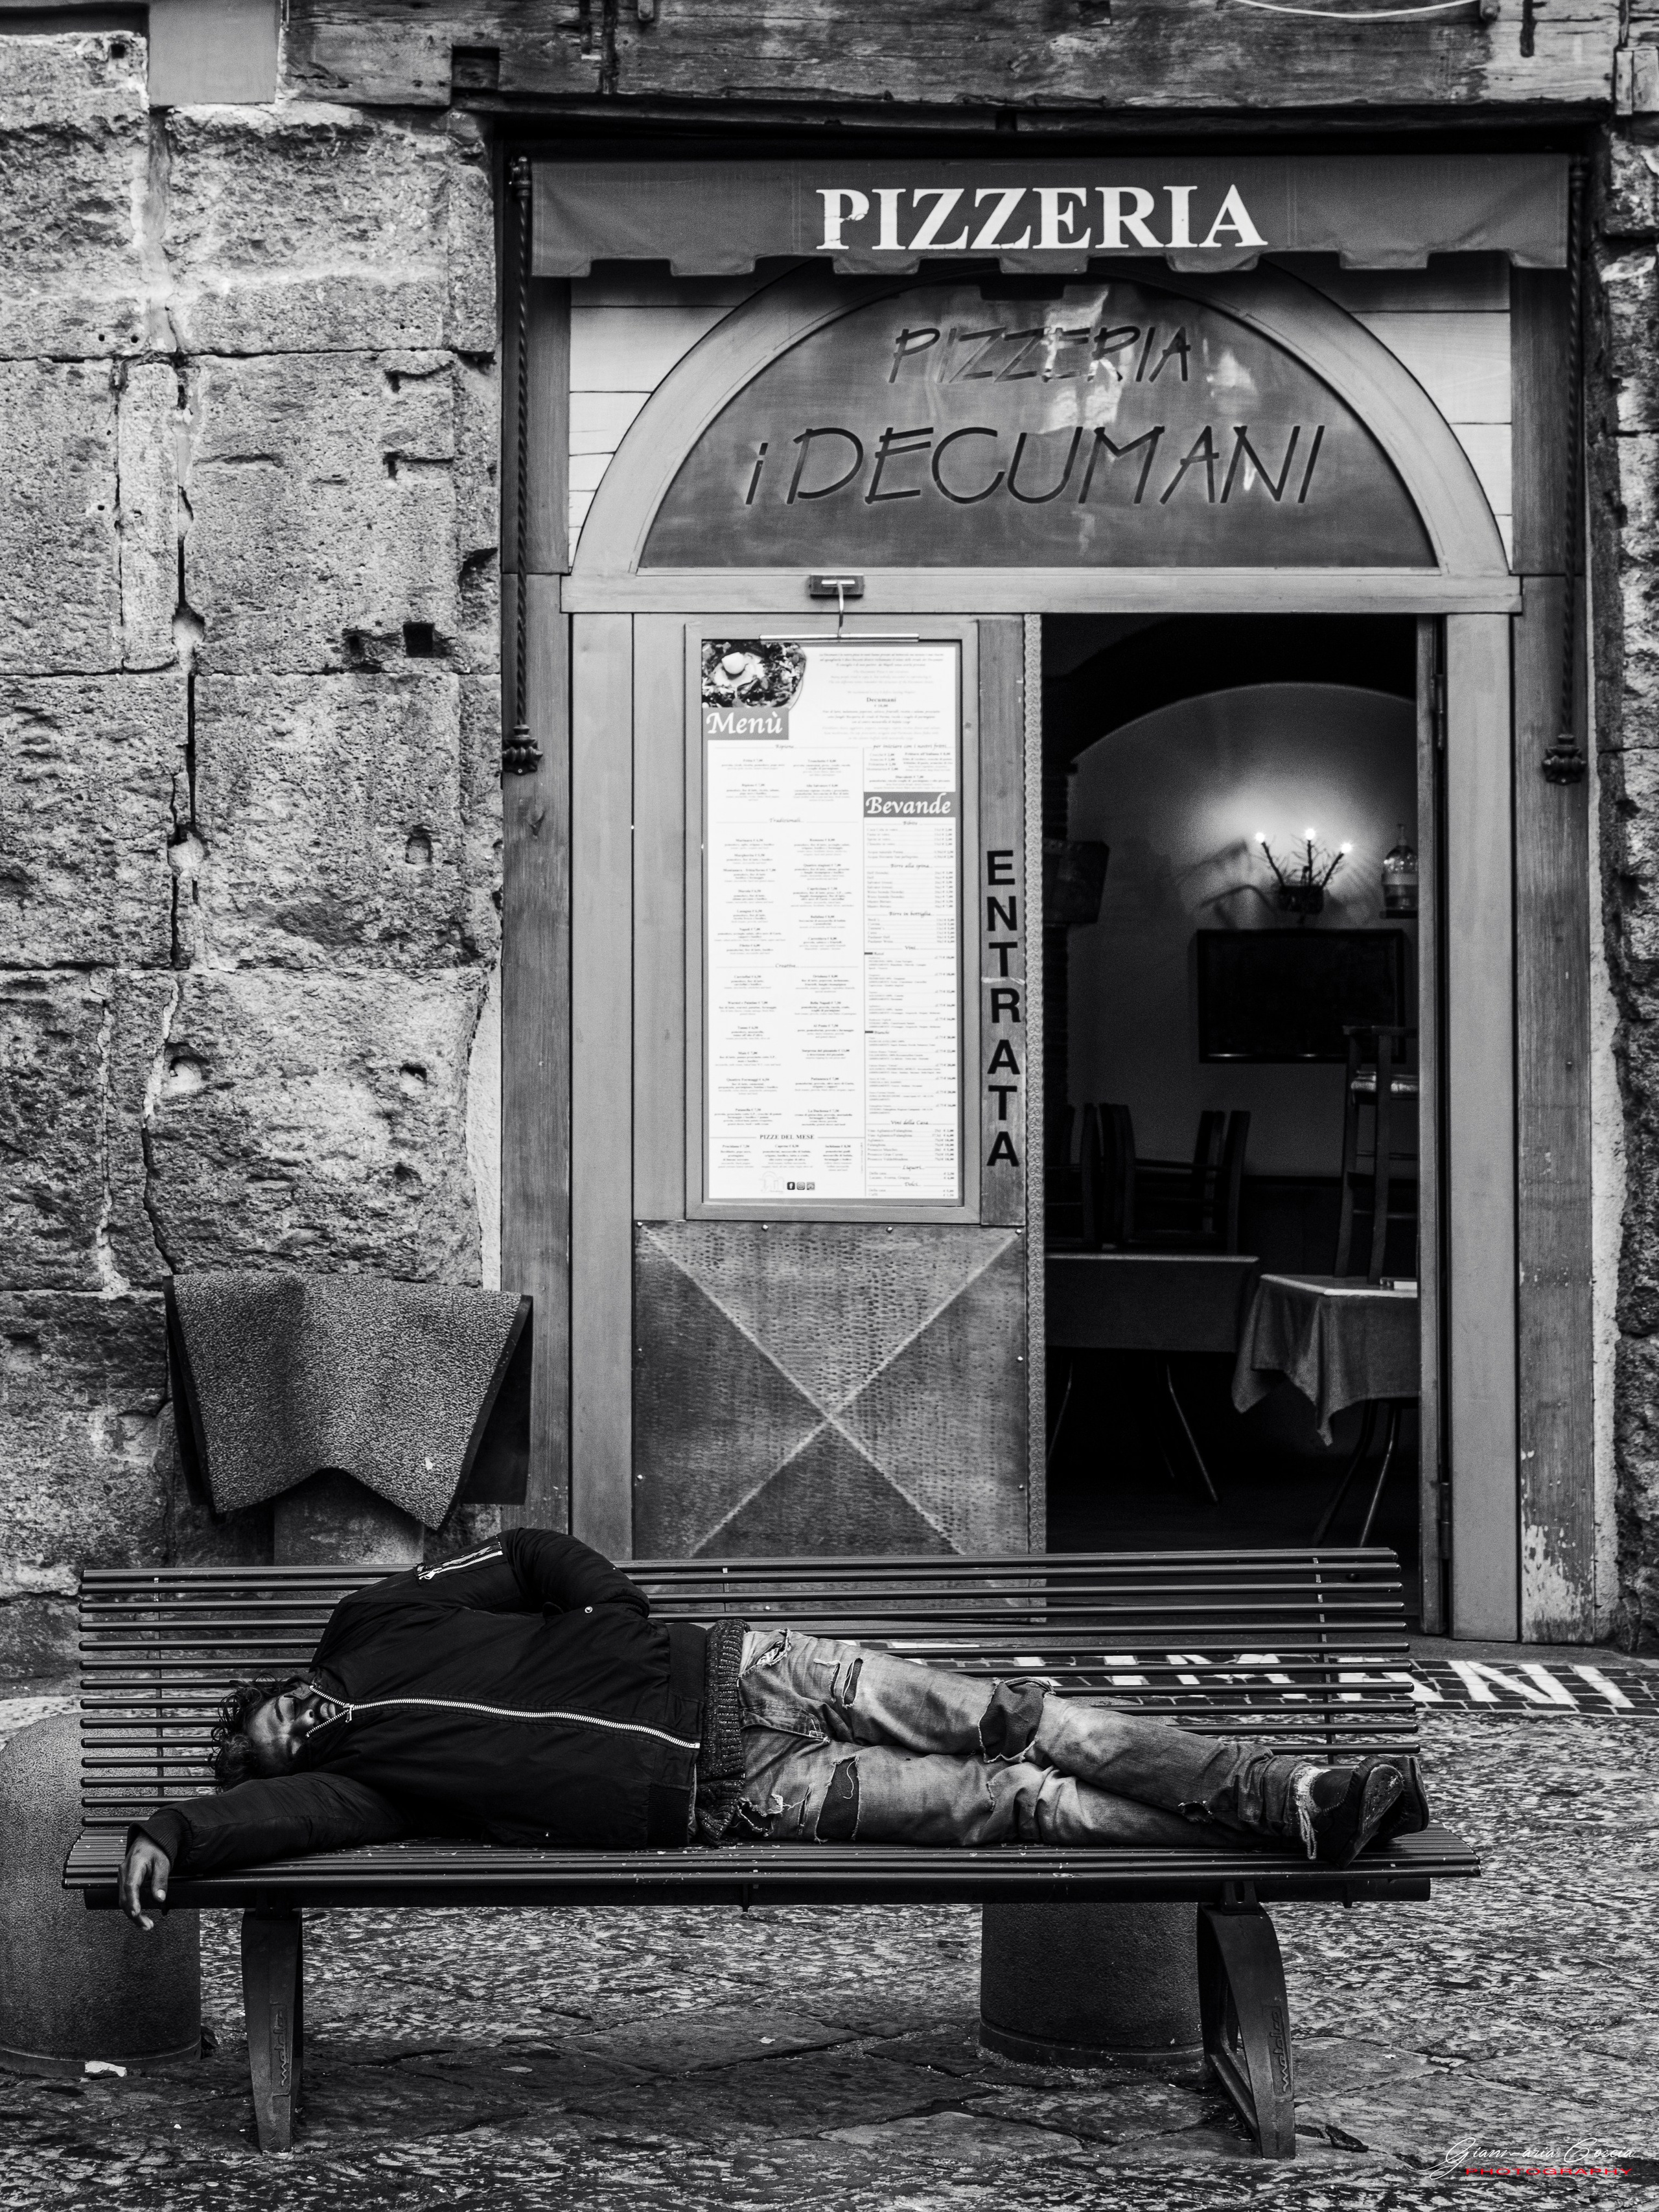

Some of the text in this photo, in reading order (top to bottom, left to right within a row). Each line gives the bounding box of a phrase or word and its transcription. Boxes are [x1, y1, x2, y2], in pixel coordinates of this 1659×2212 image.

[815, 183, 1268, 250] PIZZERIA
[888, 325, 1191, 384] PIZZERIA
[785, 425, 1325, 505] DECUMANI
[706, 710, 783, 735] Menù
[865, 792, 951, 814] Bevande
[986, 850, 1021, 1167] ENTRATA
